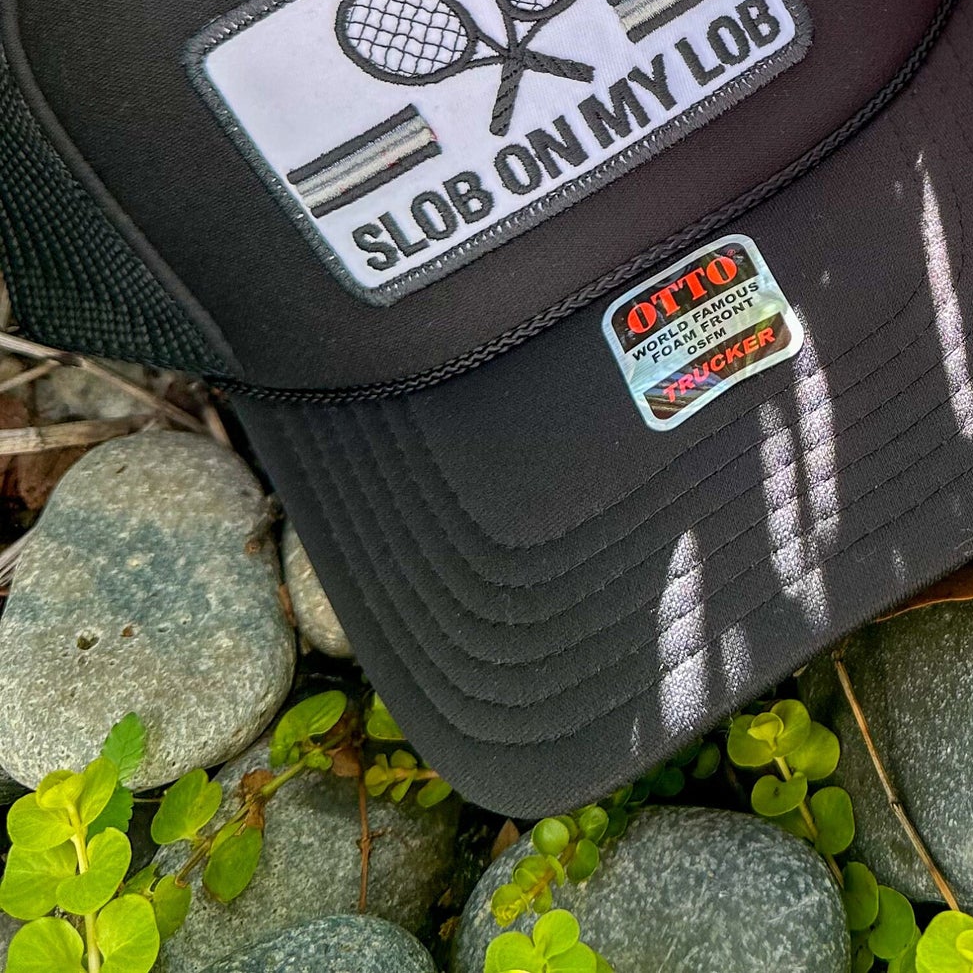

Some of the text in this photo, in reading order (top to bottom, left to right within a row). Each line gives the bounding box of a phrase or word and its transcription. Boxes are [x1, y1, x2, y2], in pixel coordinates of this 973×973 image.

[352, 170, 493, 271] SLOB
[494, 114, 590, 196] ON
[578, 54, 678, 150] MY
[627, 256, 738, 334] OTTO
[632, 281, 760, 361] WORLD FAMOUS
[651, 296, 754, 364] FOAM FRONT
[663, 327, 776, 403] TRUCKER
[687, 327, 727, 356] OSFM
